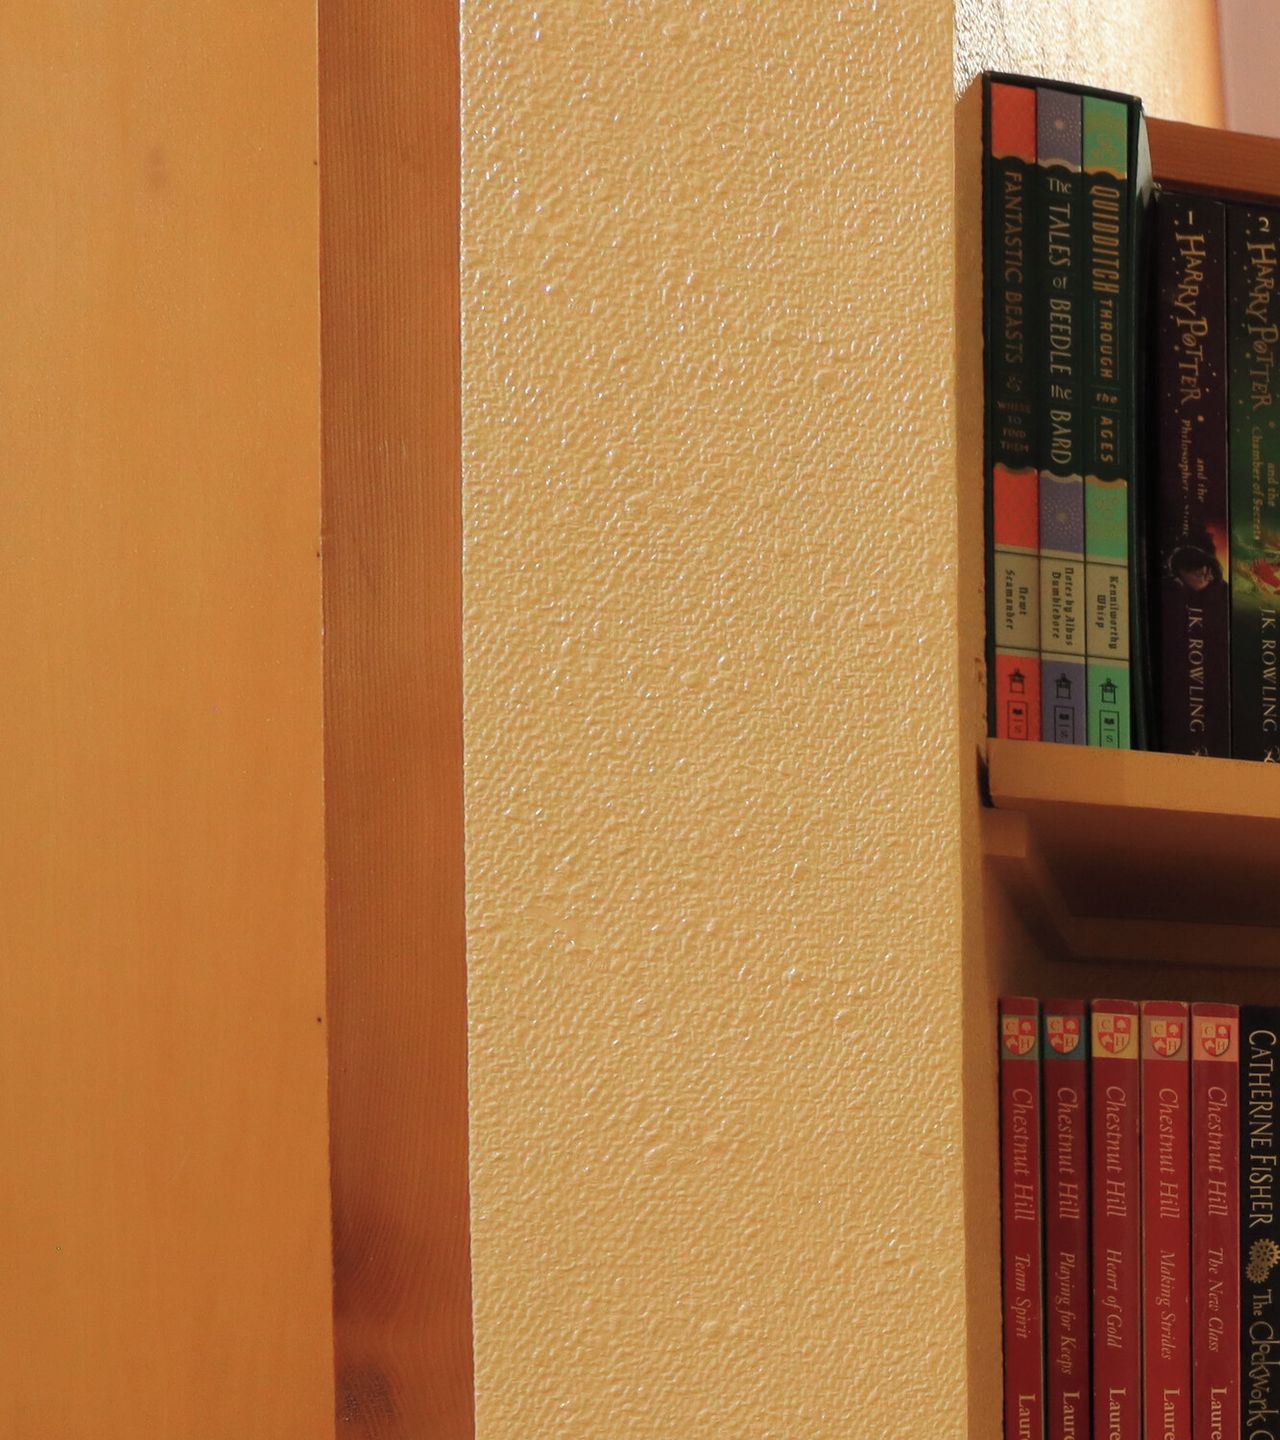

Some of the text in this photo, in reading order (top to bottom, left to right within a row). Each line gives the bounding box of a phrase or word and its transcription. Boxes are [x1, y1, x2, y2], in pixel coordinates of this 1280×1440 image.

[1004, 172, 1023, 363] FANTASTIC BEASTS
[1048, 178, 1072, 465] The TALES BEEDLE BARD
[1090, 185, 1120, 378] QUIDDITCH THROUGH
[1261, 639, 1277, 733] ROWLING
[1012, 1087, 1035, 1221] Chestnut Hill
[1105, 1086, 1128, 1218] Chestnut Hill
[1158, 1087, 1179, 1176] Chestnut
[1248, 1029, 1277, 1228] CATHERINE FISHER
